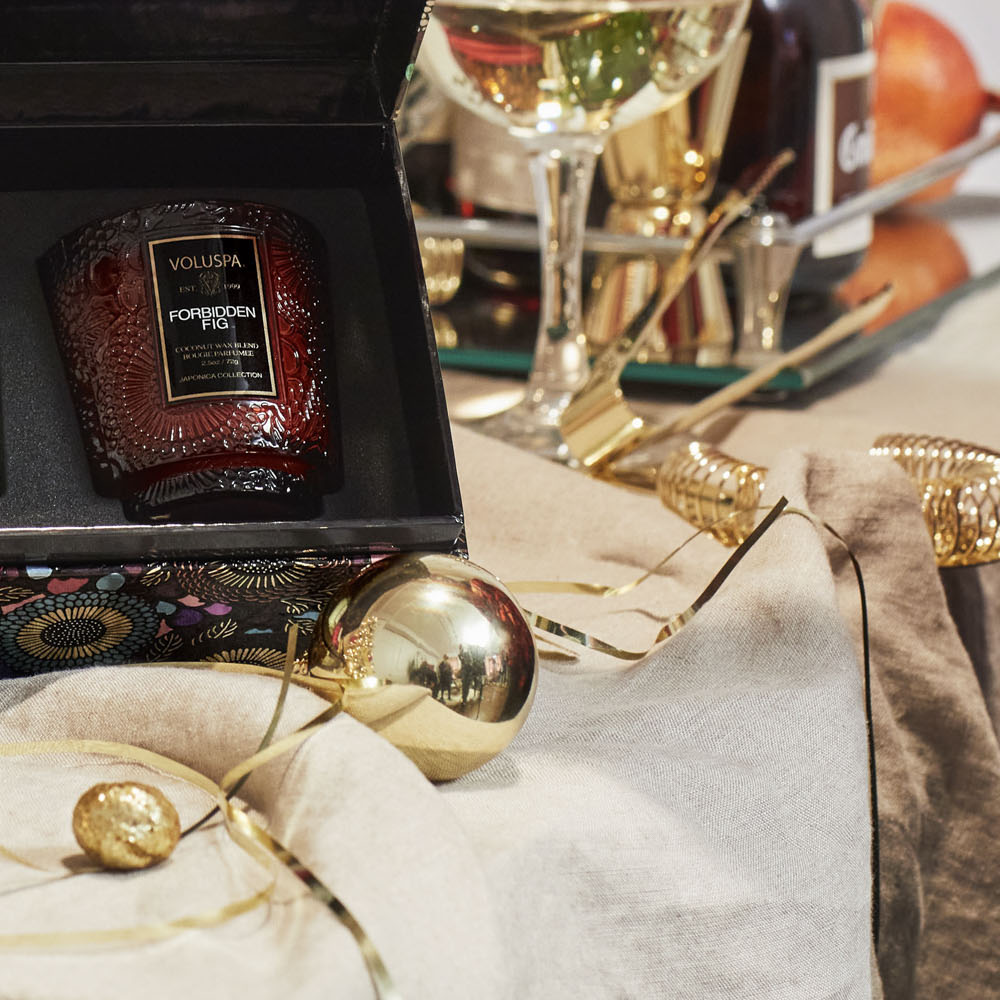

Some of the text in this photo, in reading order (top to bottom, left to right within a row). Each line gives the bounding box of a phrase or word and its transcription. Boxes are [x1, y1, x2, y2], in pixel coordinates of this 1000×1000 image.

[169, 254, 242, 271] VOLUSPA
[169, 306, 256, 322] FORBIDDEN
[202, 318, 229, 331] FIG
[218, 371, 263, 380] COLLECTION
